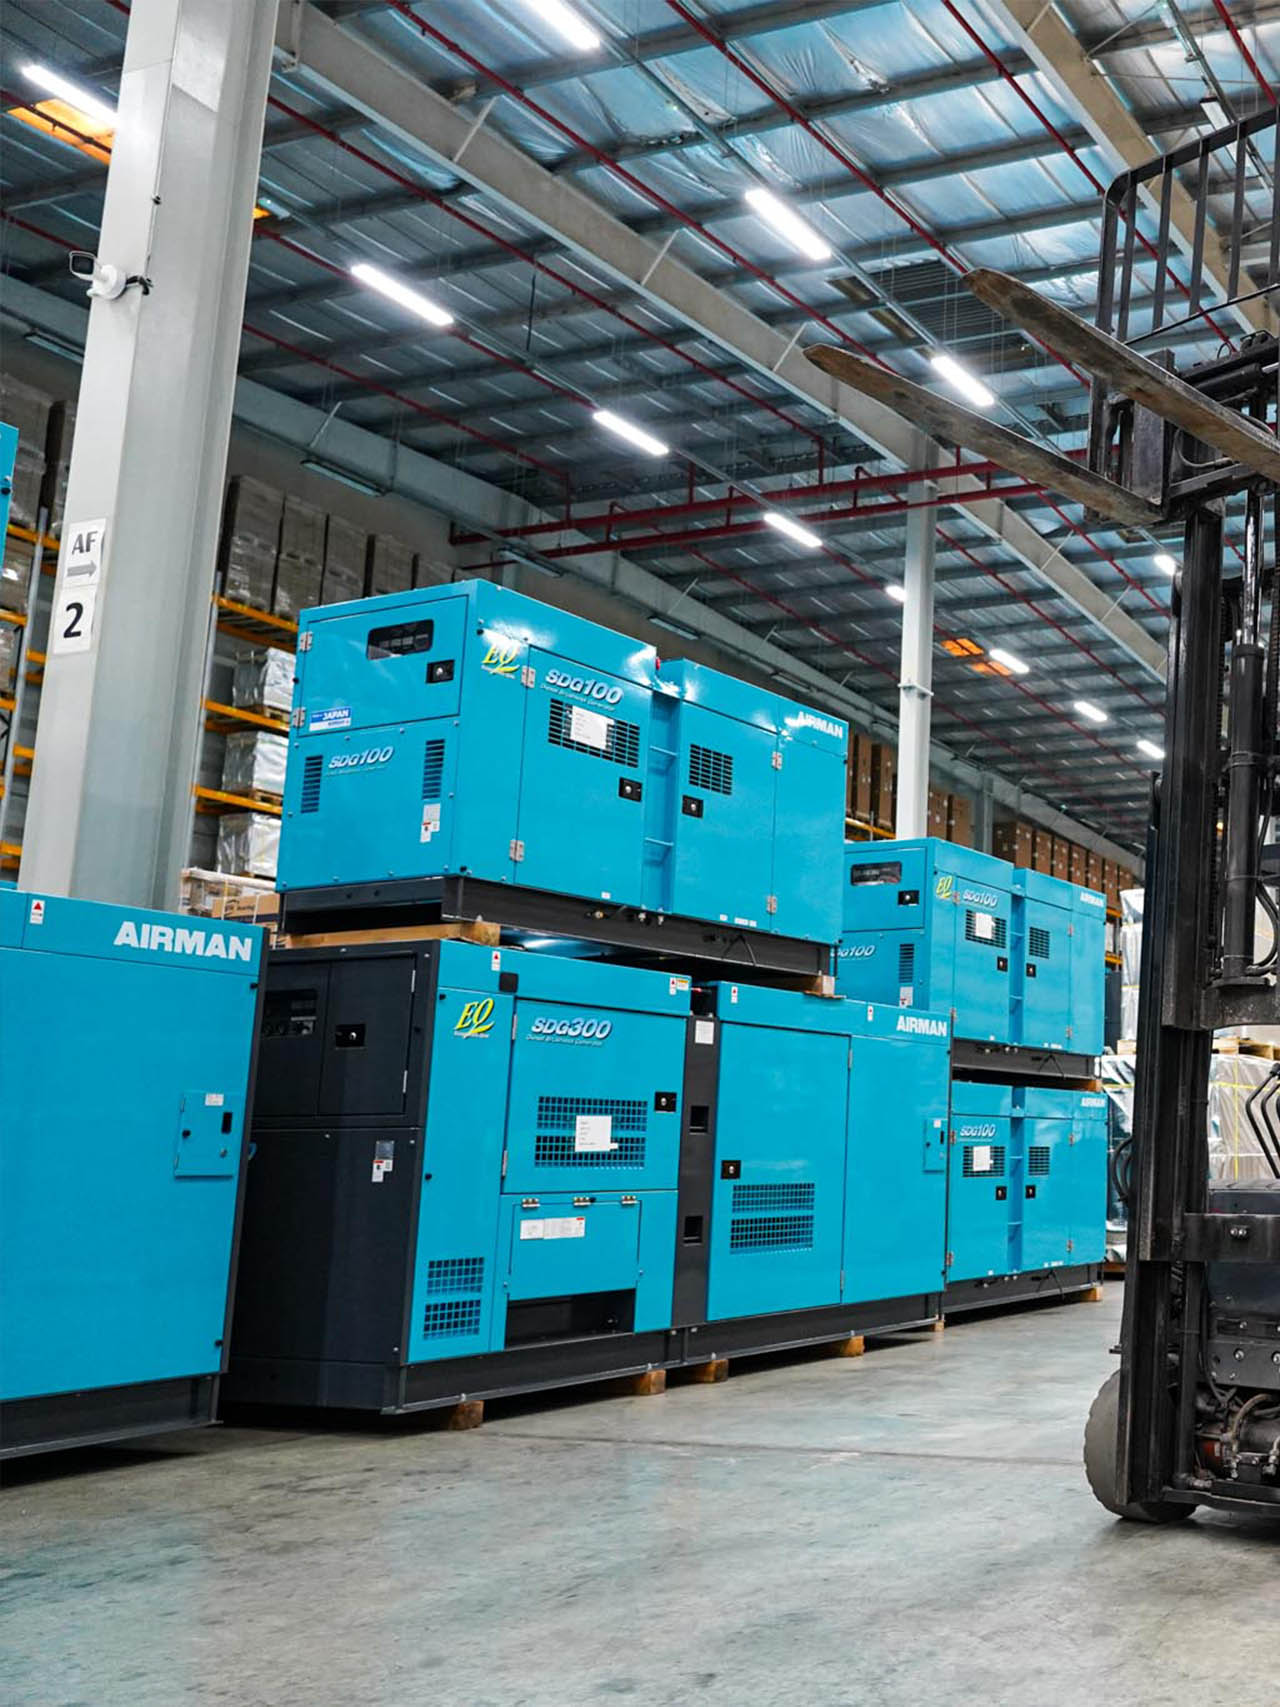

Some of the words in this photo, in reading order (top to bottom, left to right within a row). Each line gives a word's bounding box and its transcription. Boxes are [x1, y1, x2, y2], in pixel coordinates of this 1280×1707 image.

[71, 531, 98, 555] AF
[63, 602, 83, 639] 2
[545, 669, 625, 705] SDG100
[328, 746, 395, 769] SDG100
[113, 921, 252, 962] AIRMAN
[453, 997, 495, 1039] EQ
[531, 1017, 612, 1040] SDG300
[896, 1015, 948, 1037] AIRMAN
